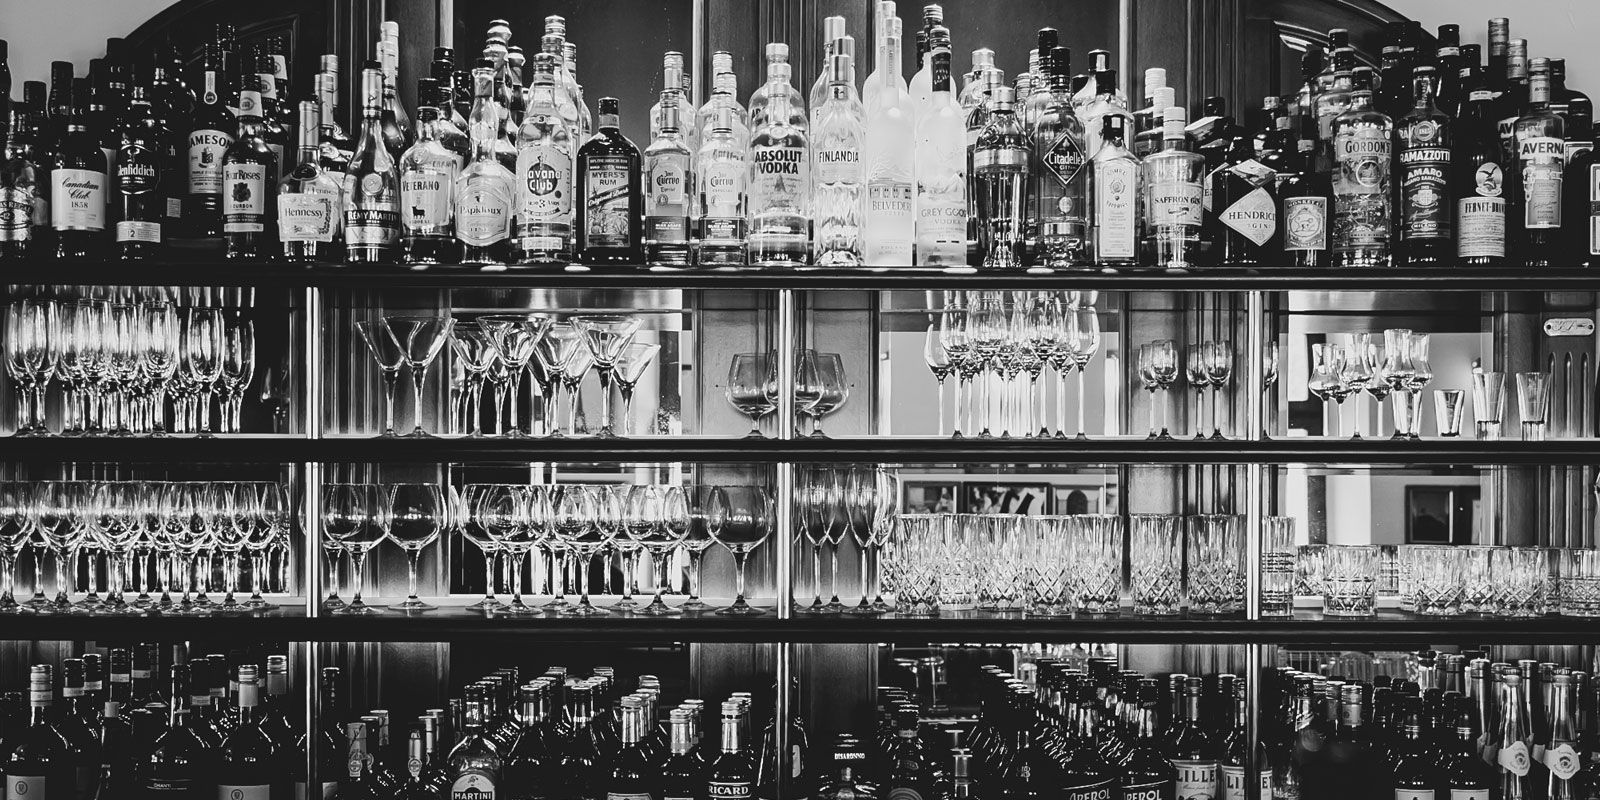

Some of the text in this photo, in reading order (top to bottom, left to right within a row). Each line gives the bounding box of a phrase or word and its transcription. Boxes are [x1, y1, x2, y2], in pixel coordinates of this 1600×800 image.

[190, 135, 231, 148] AMESON
[755, 150, 803, 163] ABSOLUT
[818, 151, 859, 163] FINLANDIA
[1048, 151, 1082, 165] Citadelle
[118, 164, 154, 177] lenfiddich
[528, 170, 563, 179] avana
[759, 162, 799, 175] VODKA
[1408, 168, 1443, 180] AMARO
[592, 171, 626, 179] MYERS'S
[656, 174, 680, 187] Cuervo
[62, 177, 100, 190] Canadian
[402, 180, 440, 192] VEERANO
[530, 180, 553, 191] Club
[69, 189, 92, 200] Club
[1154, 196, 1189, 204] SAFFRON
[285, 207, 324, 219] Hennessy
[921, 208, 942, 218] GREY
[1228, 211, 1276, 221] HENDRIC
[834, 752, 866, 760] DISARONNO
[1176, 769, 1215, 783] LILLE
[454, 792, 492, 800] MARTINI
[708, 785, 749, 796] RICARD
